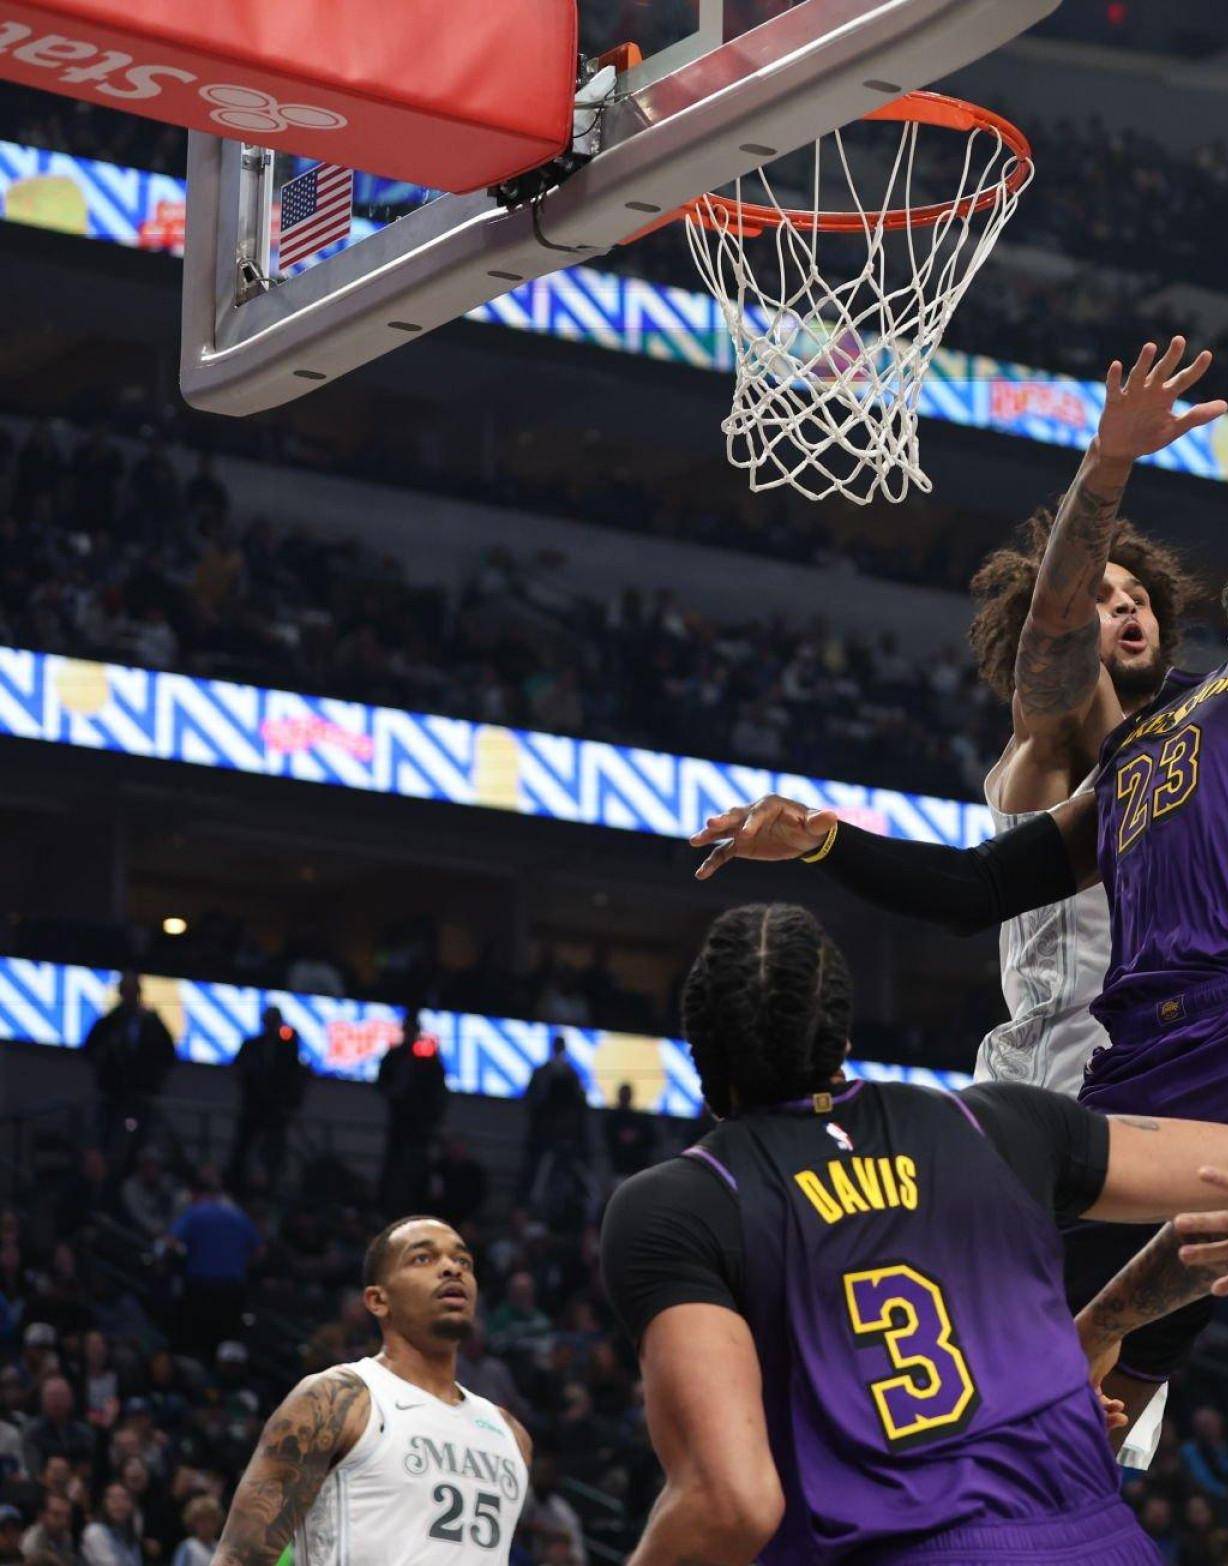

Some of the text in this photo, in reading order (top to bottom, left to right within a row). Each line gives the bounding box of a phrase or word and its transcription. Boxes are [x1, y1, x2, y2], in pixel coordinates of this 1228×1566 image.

[1117, 722, 1201, 853] 23
[794, 1155, 919, 1225] DAVIS
[843, 1264, 976, 1442] 3
[403, 1434, 520, 1502] MAVS
[427, 1482, 502, 1550] 25
